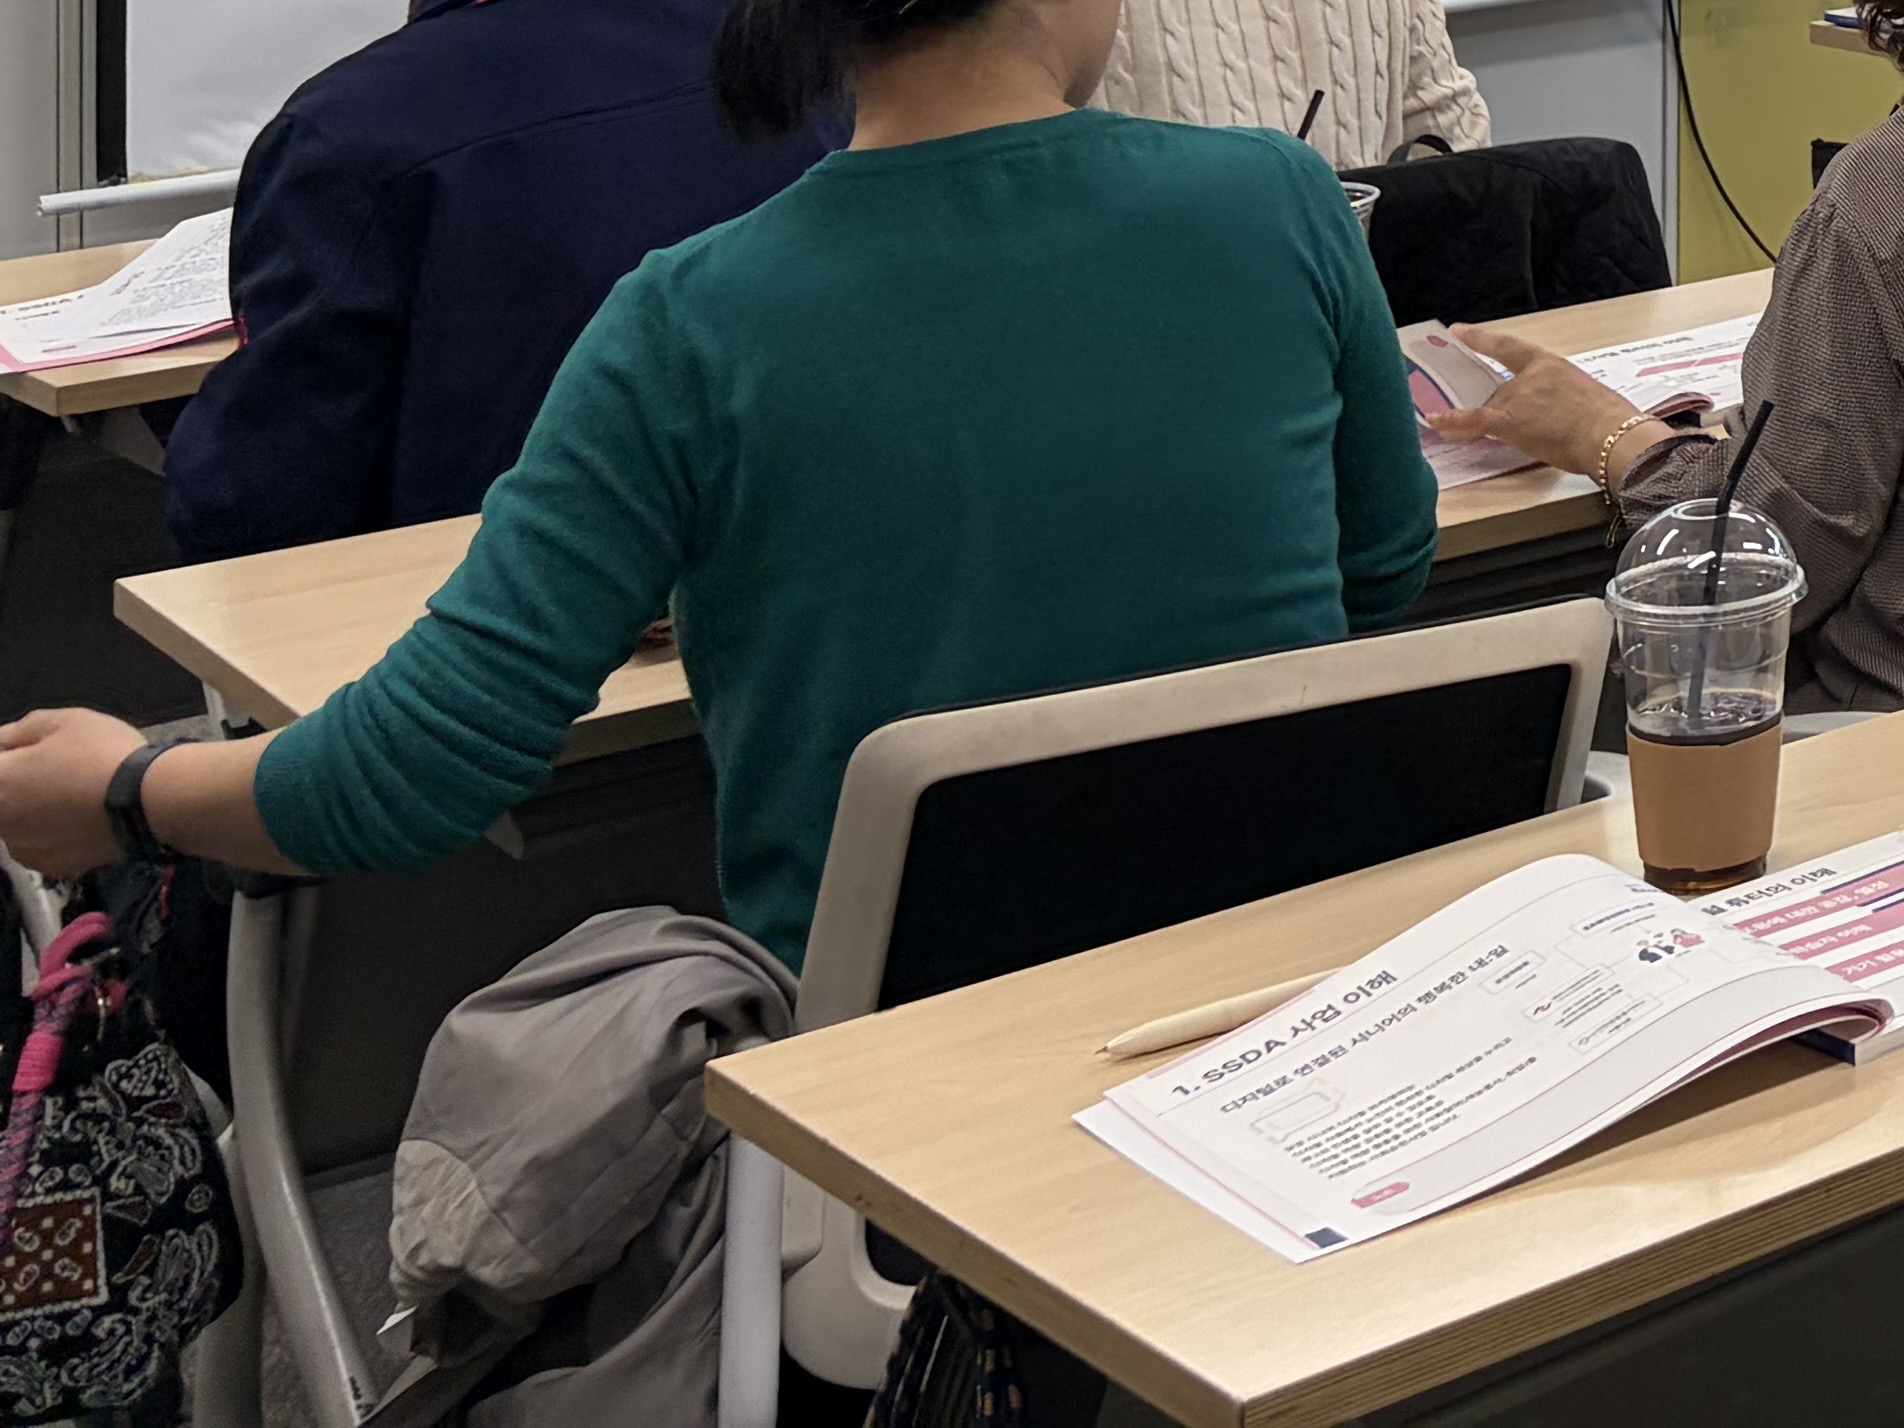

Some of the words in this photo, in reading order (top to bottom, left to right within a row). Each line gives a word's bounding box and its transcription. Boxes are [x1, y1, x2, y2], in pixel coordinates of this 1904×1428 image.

[1172, 1085, 1201, 1095] 1.
[1201, 1038, 1288, 1084] SSDA
[1290, 1003, 1342, 1039] 사업
[1342, 969, 1398, 1005] 이해
[1350, 1003, 1418, 1048] 시니어의
